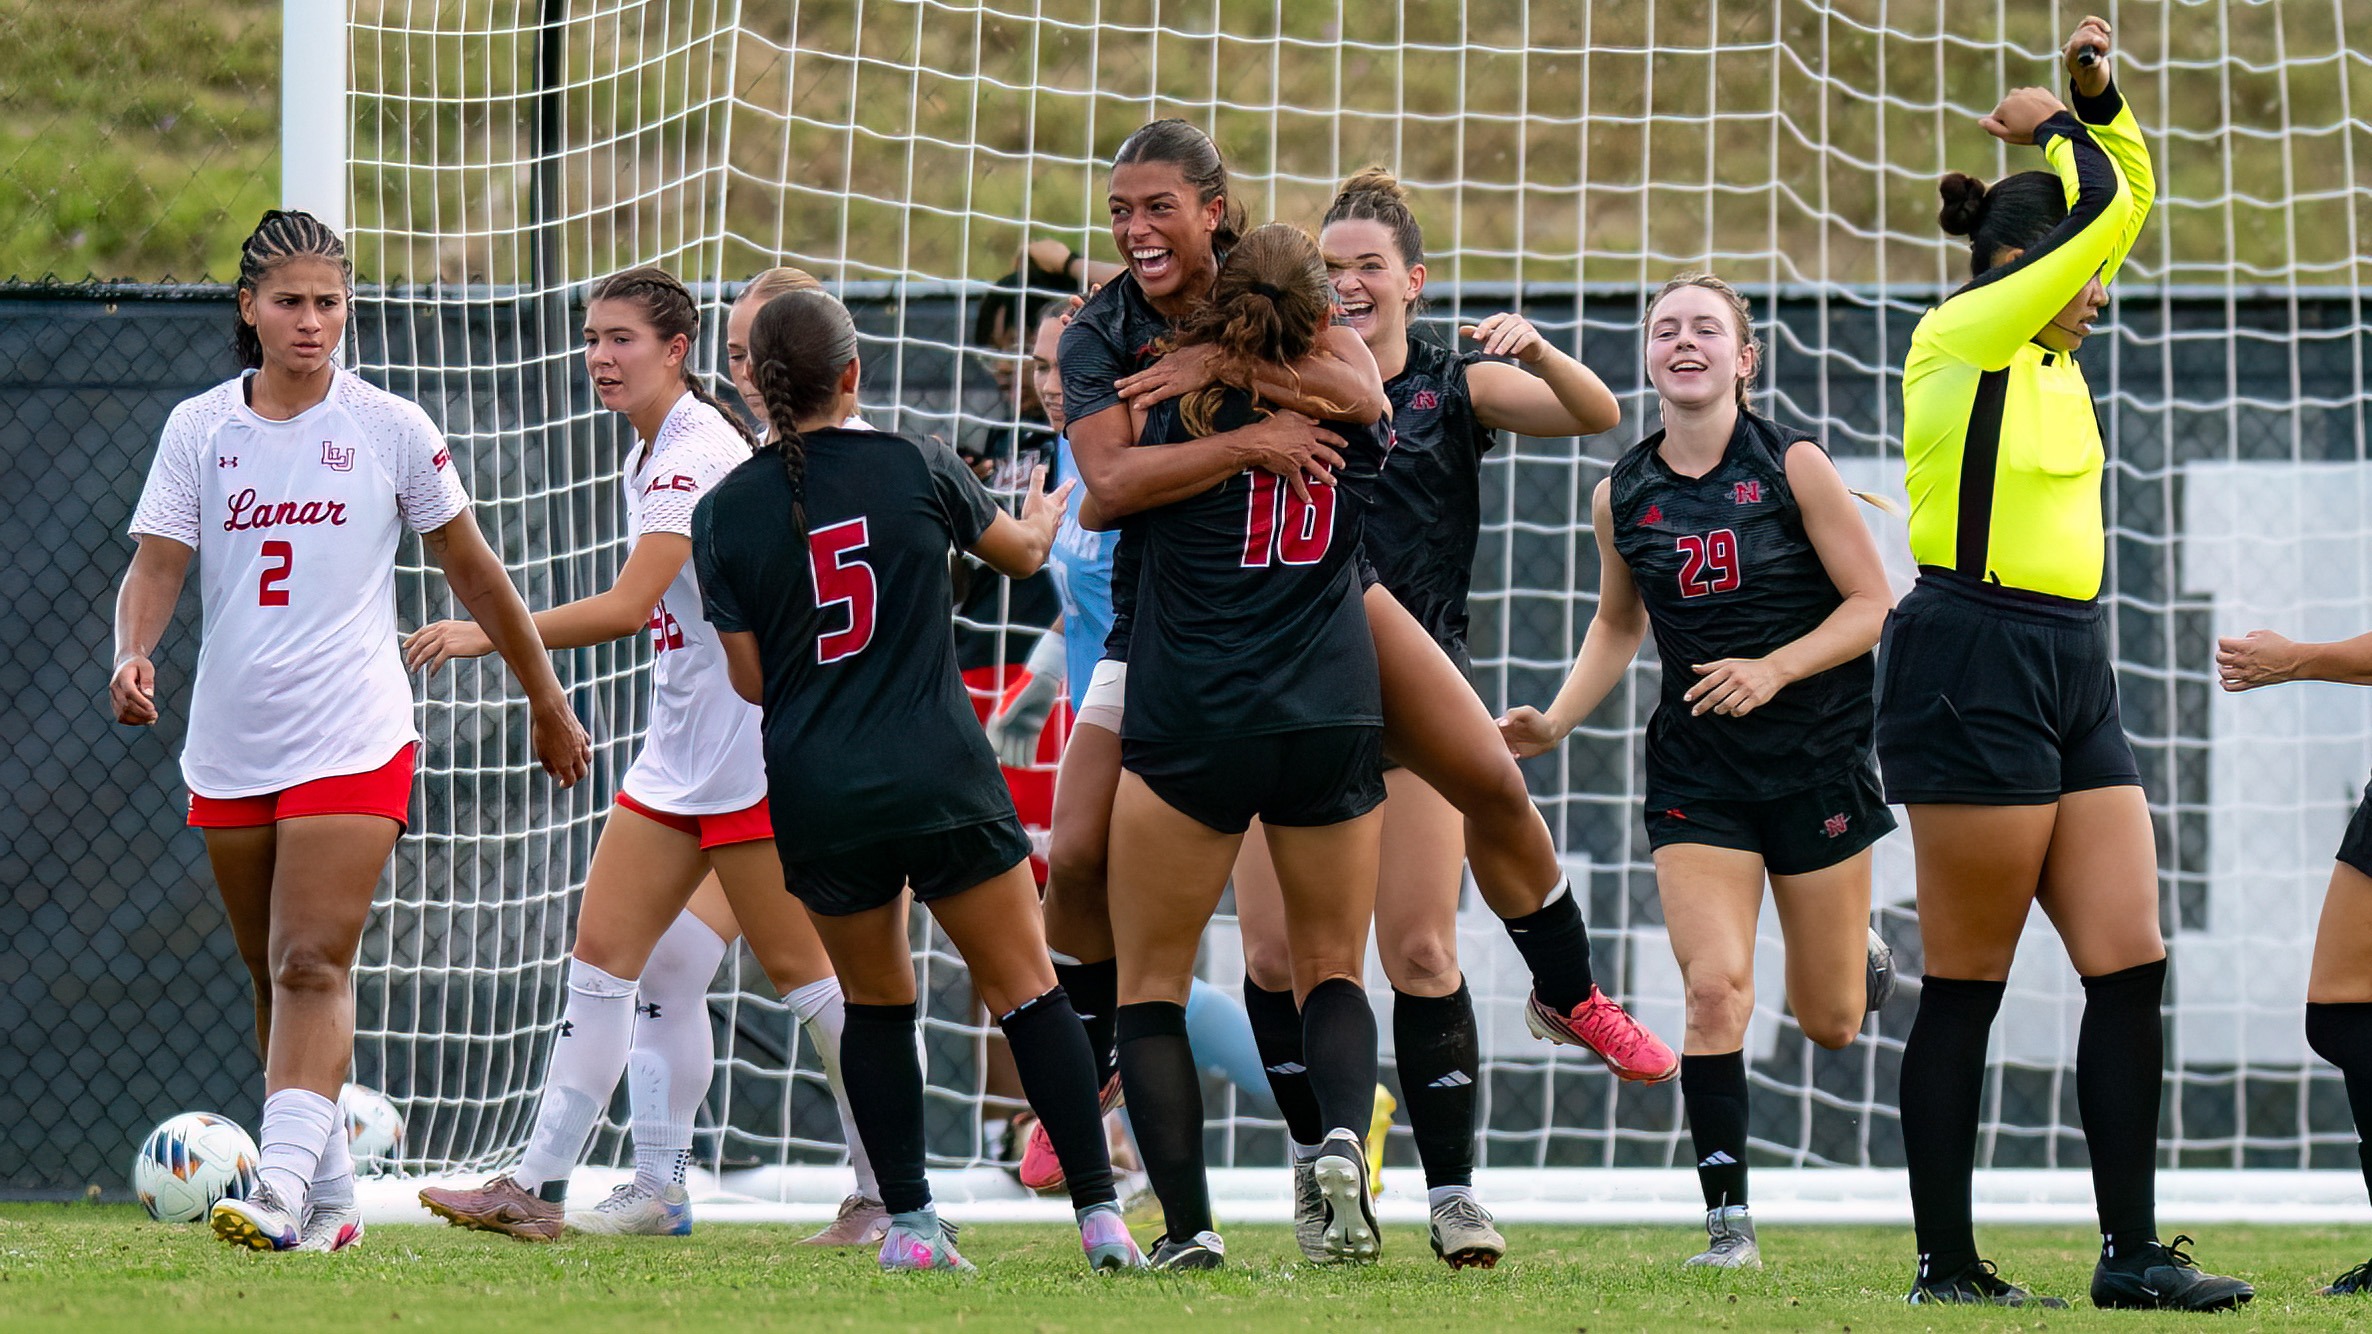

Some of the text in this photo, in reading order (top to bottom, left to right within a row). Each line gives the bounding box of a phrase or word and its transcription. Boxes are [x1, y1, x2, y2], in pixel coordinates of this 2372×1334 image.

[321, 440, 356, 472] LU
[1734, 480, 1762, 505] N
[258, 540, 294, 606] 2
[808, 515, 878, 666] 5
[1676, 528, 1741, 599] 29
